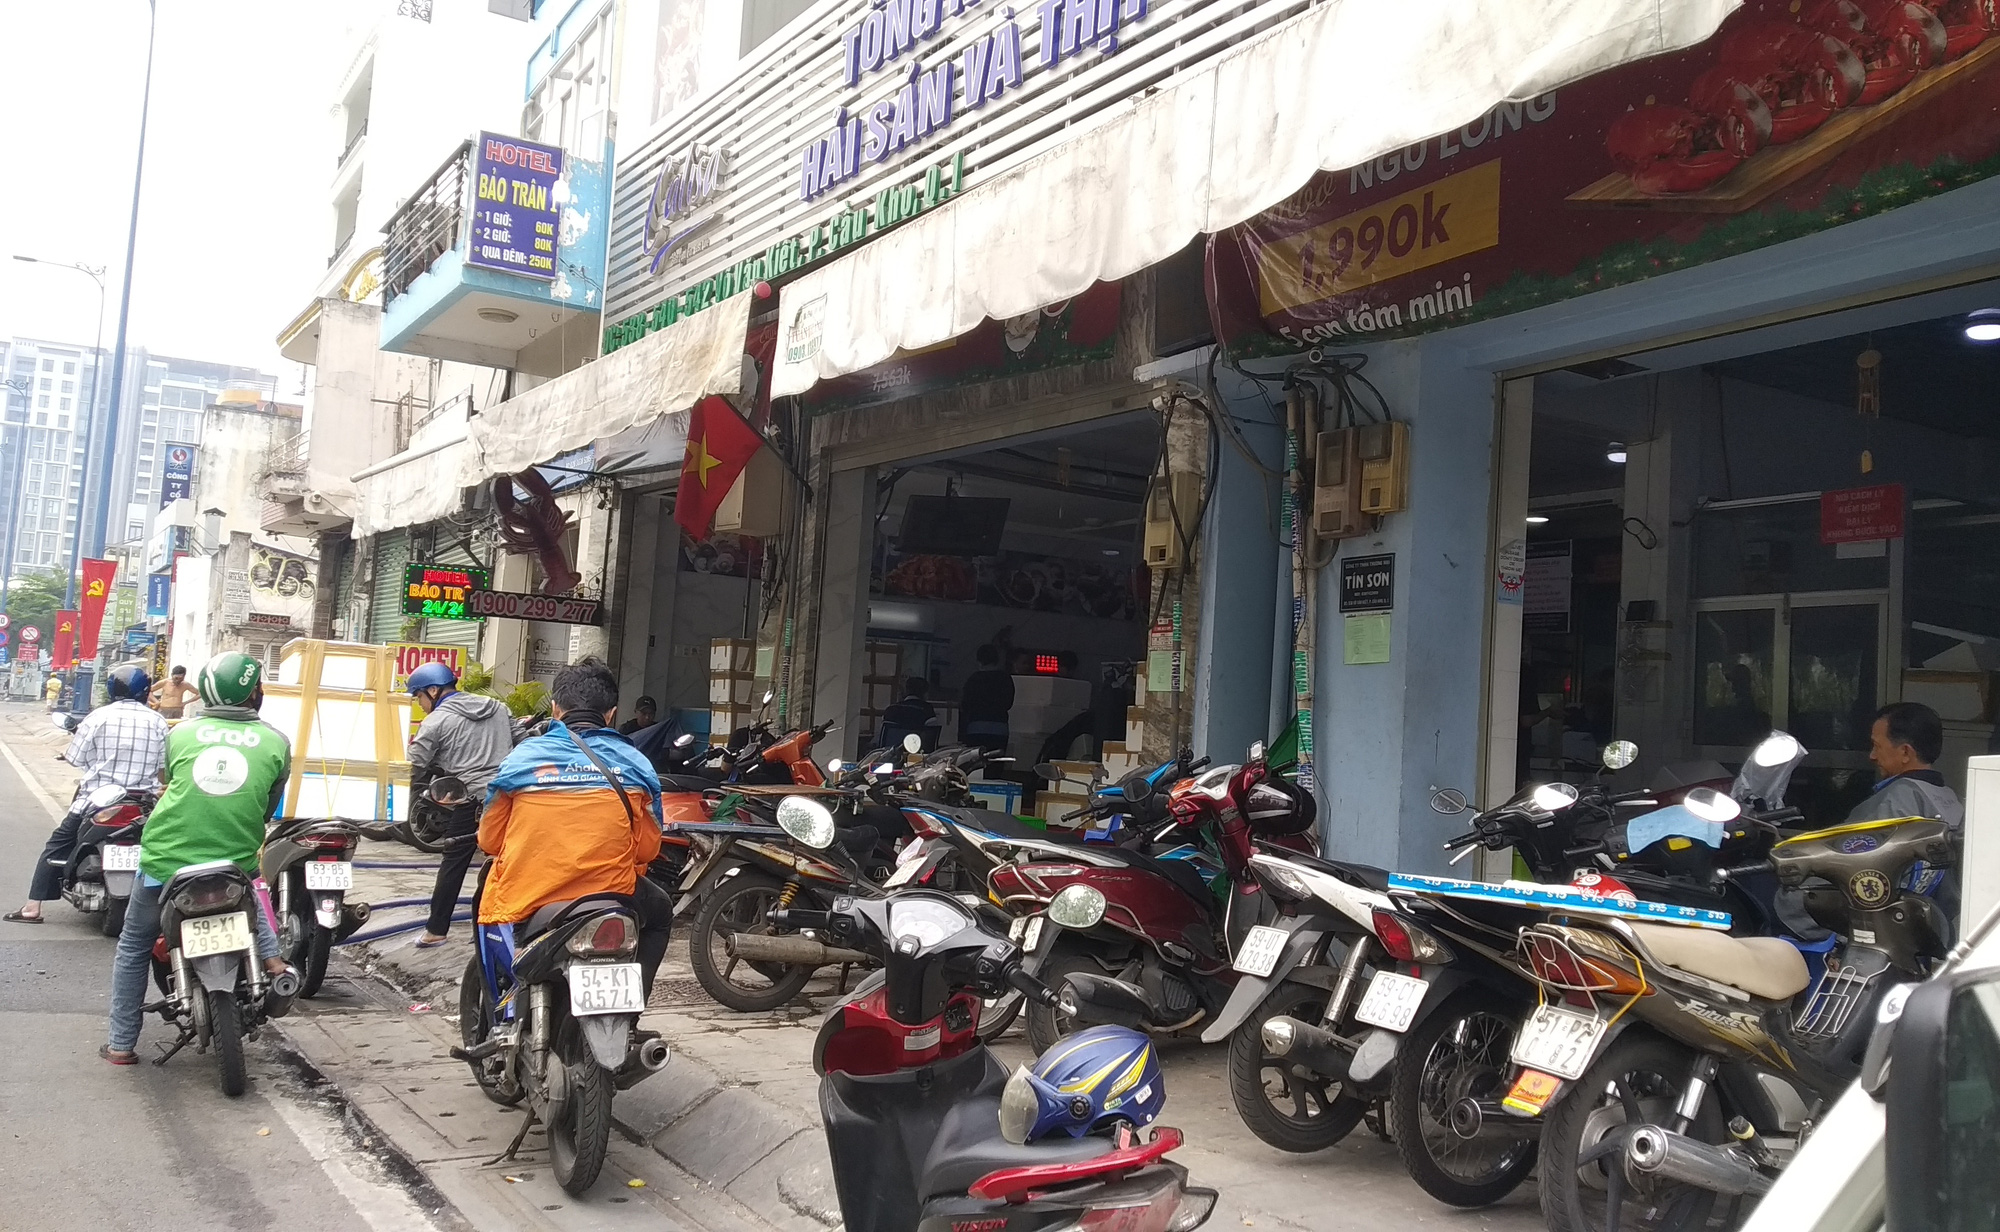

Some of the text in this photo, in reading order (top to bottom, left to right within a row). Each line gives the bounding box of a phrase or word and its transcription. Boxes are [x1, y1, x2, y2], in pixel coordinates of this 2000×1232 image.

[799, 105, 863, 202] HẢI
[865, 61, 955, 163] SẢN
[963, 4, 1023, 110] VÀ
[485, 140, 557, 174] HOTEL
[478, 167, 507, 203] BẢO
[511, 178, 547, 211] TRÂN
[484, 211, 490, 223] 1
[535, 221, 554, 235] 60K
[828, 200, 868, 251] Cầu
[874, 184, 922, 230] Kho,
[483, 227, 489, 239] 2
[534, 238, 553, 252] 80K
[481, 245, 553, 270] QUA ĐÊM: 250K
[1347, 303, 1403, 335] tôm
[1409, 272, 1473, 322] mini
[166, 472, 188, 480] CÔNG
[423, 569, 472, 586] HOTEL
[1345, 571, 1390, 589] TÍN SƠN
[408, 580, 440, 598] BẢO
[471, 591, 598, 622] 1900 299 277
[396, 646, 464, 679] HOTEL
[239, 663, 256, 686] Grab
[196, 724, 261, 748] Grab
[110, 847, 139, 857] 54-P5
[110, 858, 138, 868] 1588
[1853, 871, 1880, 882] CHELSEA
[192, 916, 235, 936] 59-X1
[1250, 930, 1281, 951] 59-U1
[581, 968, 629, 988] 54-K1
[582, 989, 633, 1010] 8574
[951, 1218, 1008, 1232] VISION
